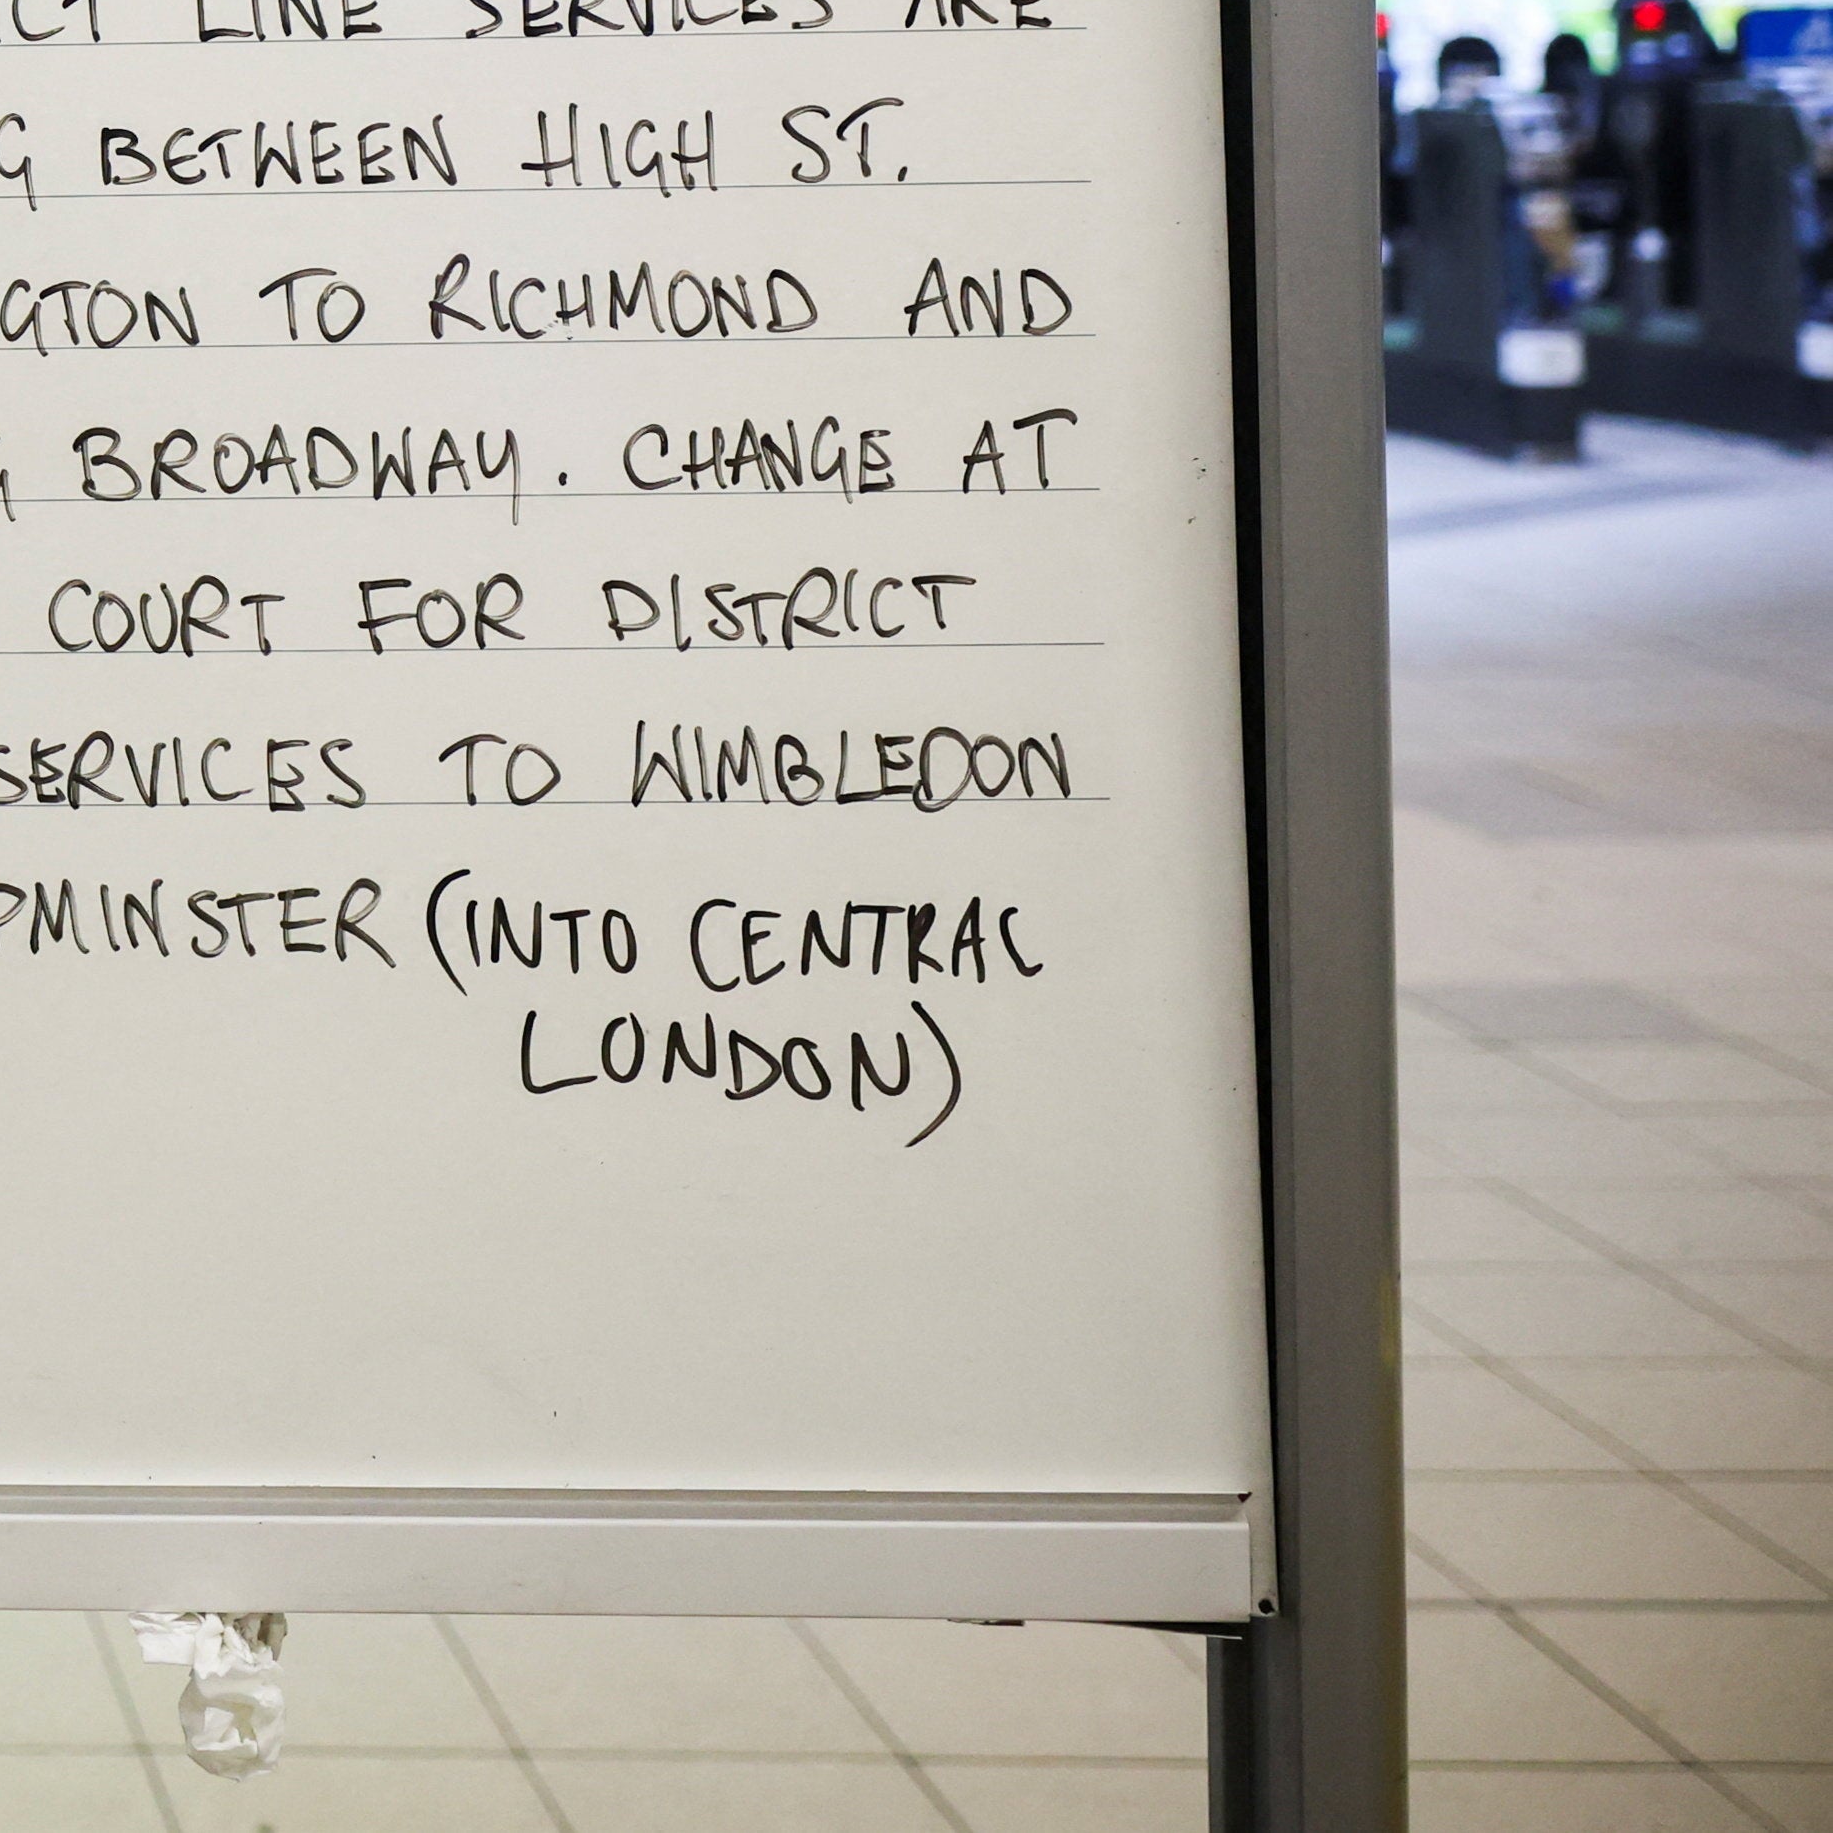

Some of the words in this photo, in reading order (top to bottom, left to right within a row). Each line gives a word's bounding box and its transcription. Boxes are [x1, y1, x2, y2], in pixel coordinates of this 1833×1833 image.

[99, 112, 459, 194] BETWEEN
[516, 101, 720, 200] HIGH
[780, 96, 909, 185] ST.
[257, 266, 367, 345] TO
[427, 252, 819, 344] RICHMOND
[903, 257, 1074, 338] AND
[623, 416, 899, 504] CHANGE
[963, 409, 1079, 496] AT
[47, 574, 286, 658] COURT
[356, 571, 527, 657] FOR
[600, 565, 978, 654] DISTRICT
[439, 733, 563, 806] TO
[631, 719, 1073, 814] WIMBLEDON
[424, 867, 639, 998] (INTO
[519, 999, 963, 1149] LONDON)
